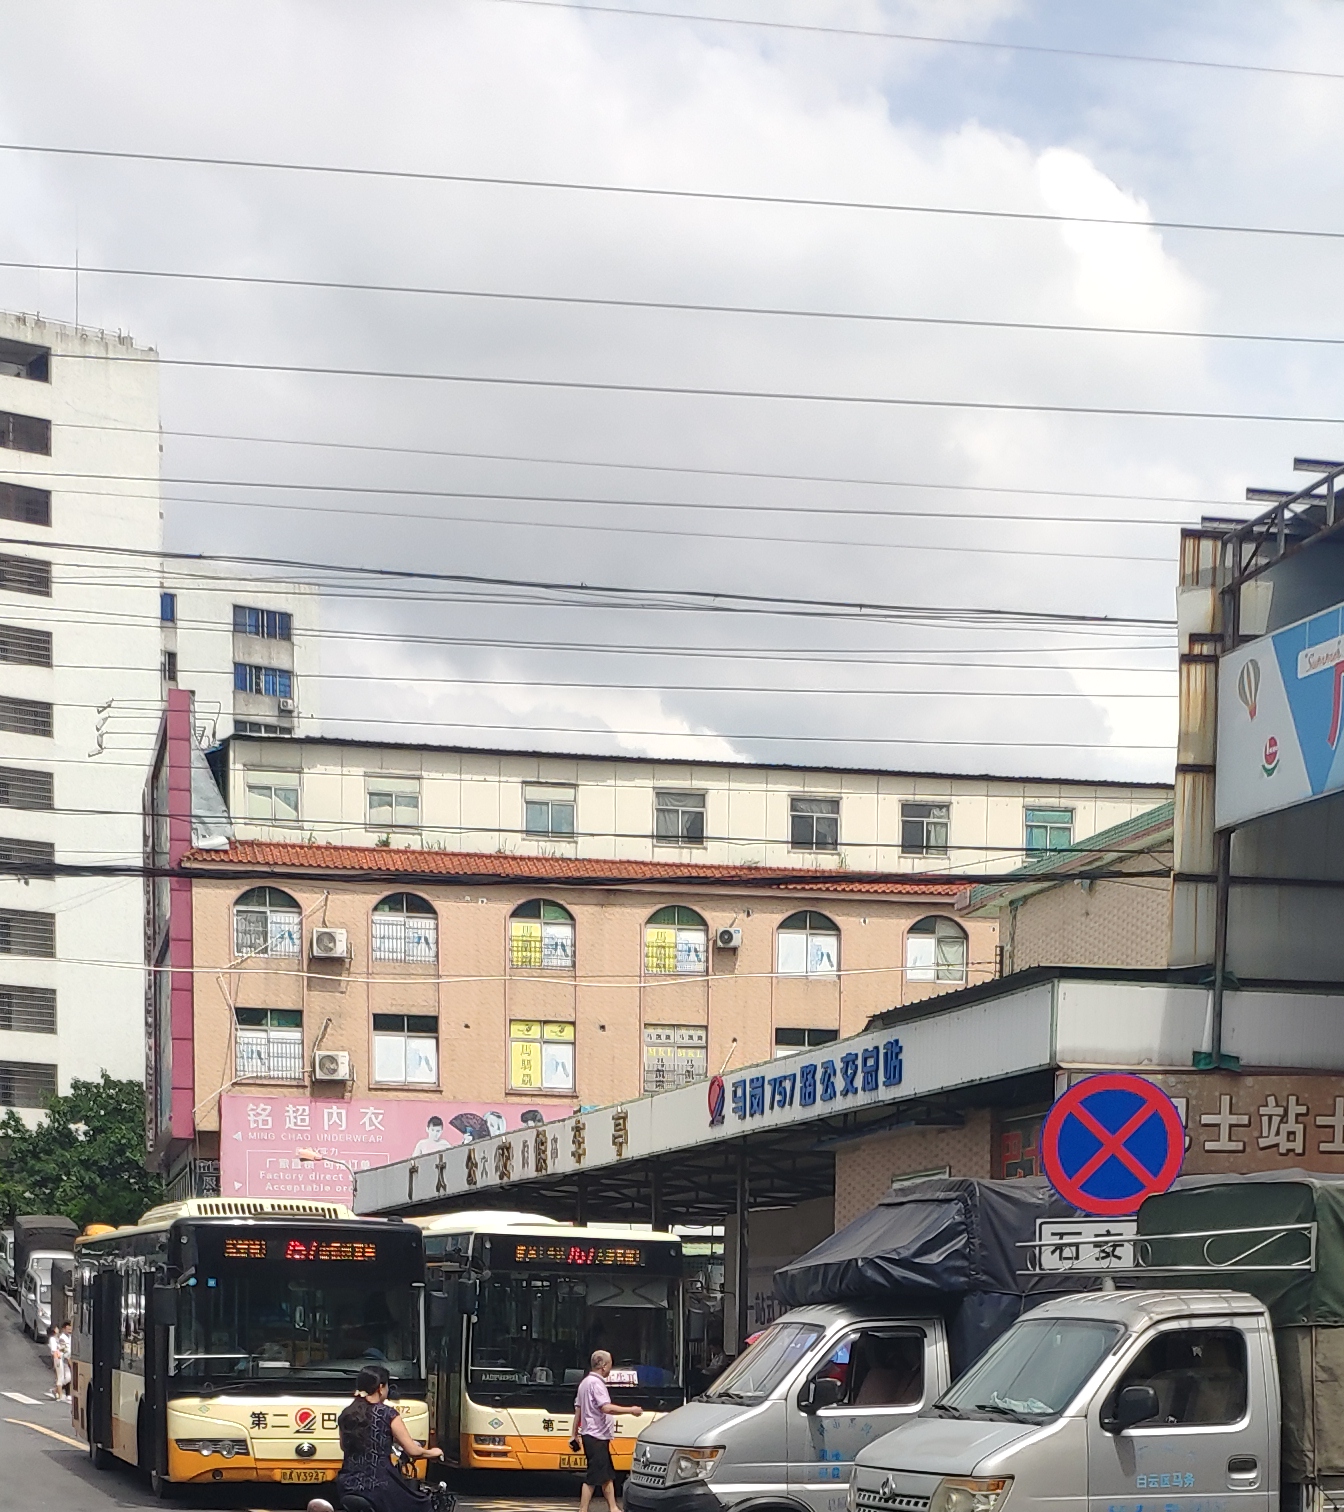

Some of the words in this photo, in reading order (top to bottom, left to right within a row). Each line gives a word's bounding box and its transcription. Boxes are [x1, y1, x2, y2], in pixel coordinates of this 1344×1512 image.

[731, 1038, 903, 1120] 马岗757路公交总站
[247, 1103, 385, 1131] 铭超内衣
[248, 1132, 276, 1141] MING
[281, 1133, 311, 1142] CHAO
[316, 1133, 383, 1143] UNDERWEAR
[259, 1170, 304, 1182] Factory
[309, 1171, 344, 1181] direct
[265, 1182, 331, 1193] Acceptable
[250, 1411, 291, 1430] 第二
[542, 1418, 570, 1432] 第二
[1136, 1472, 1196, 1489] 白云区马务
